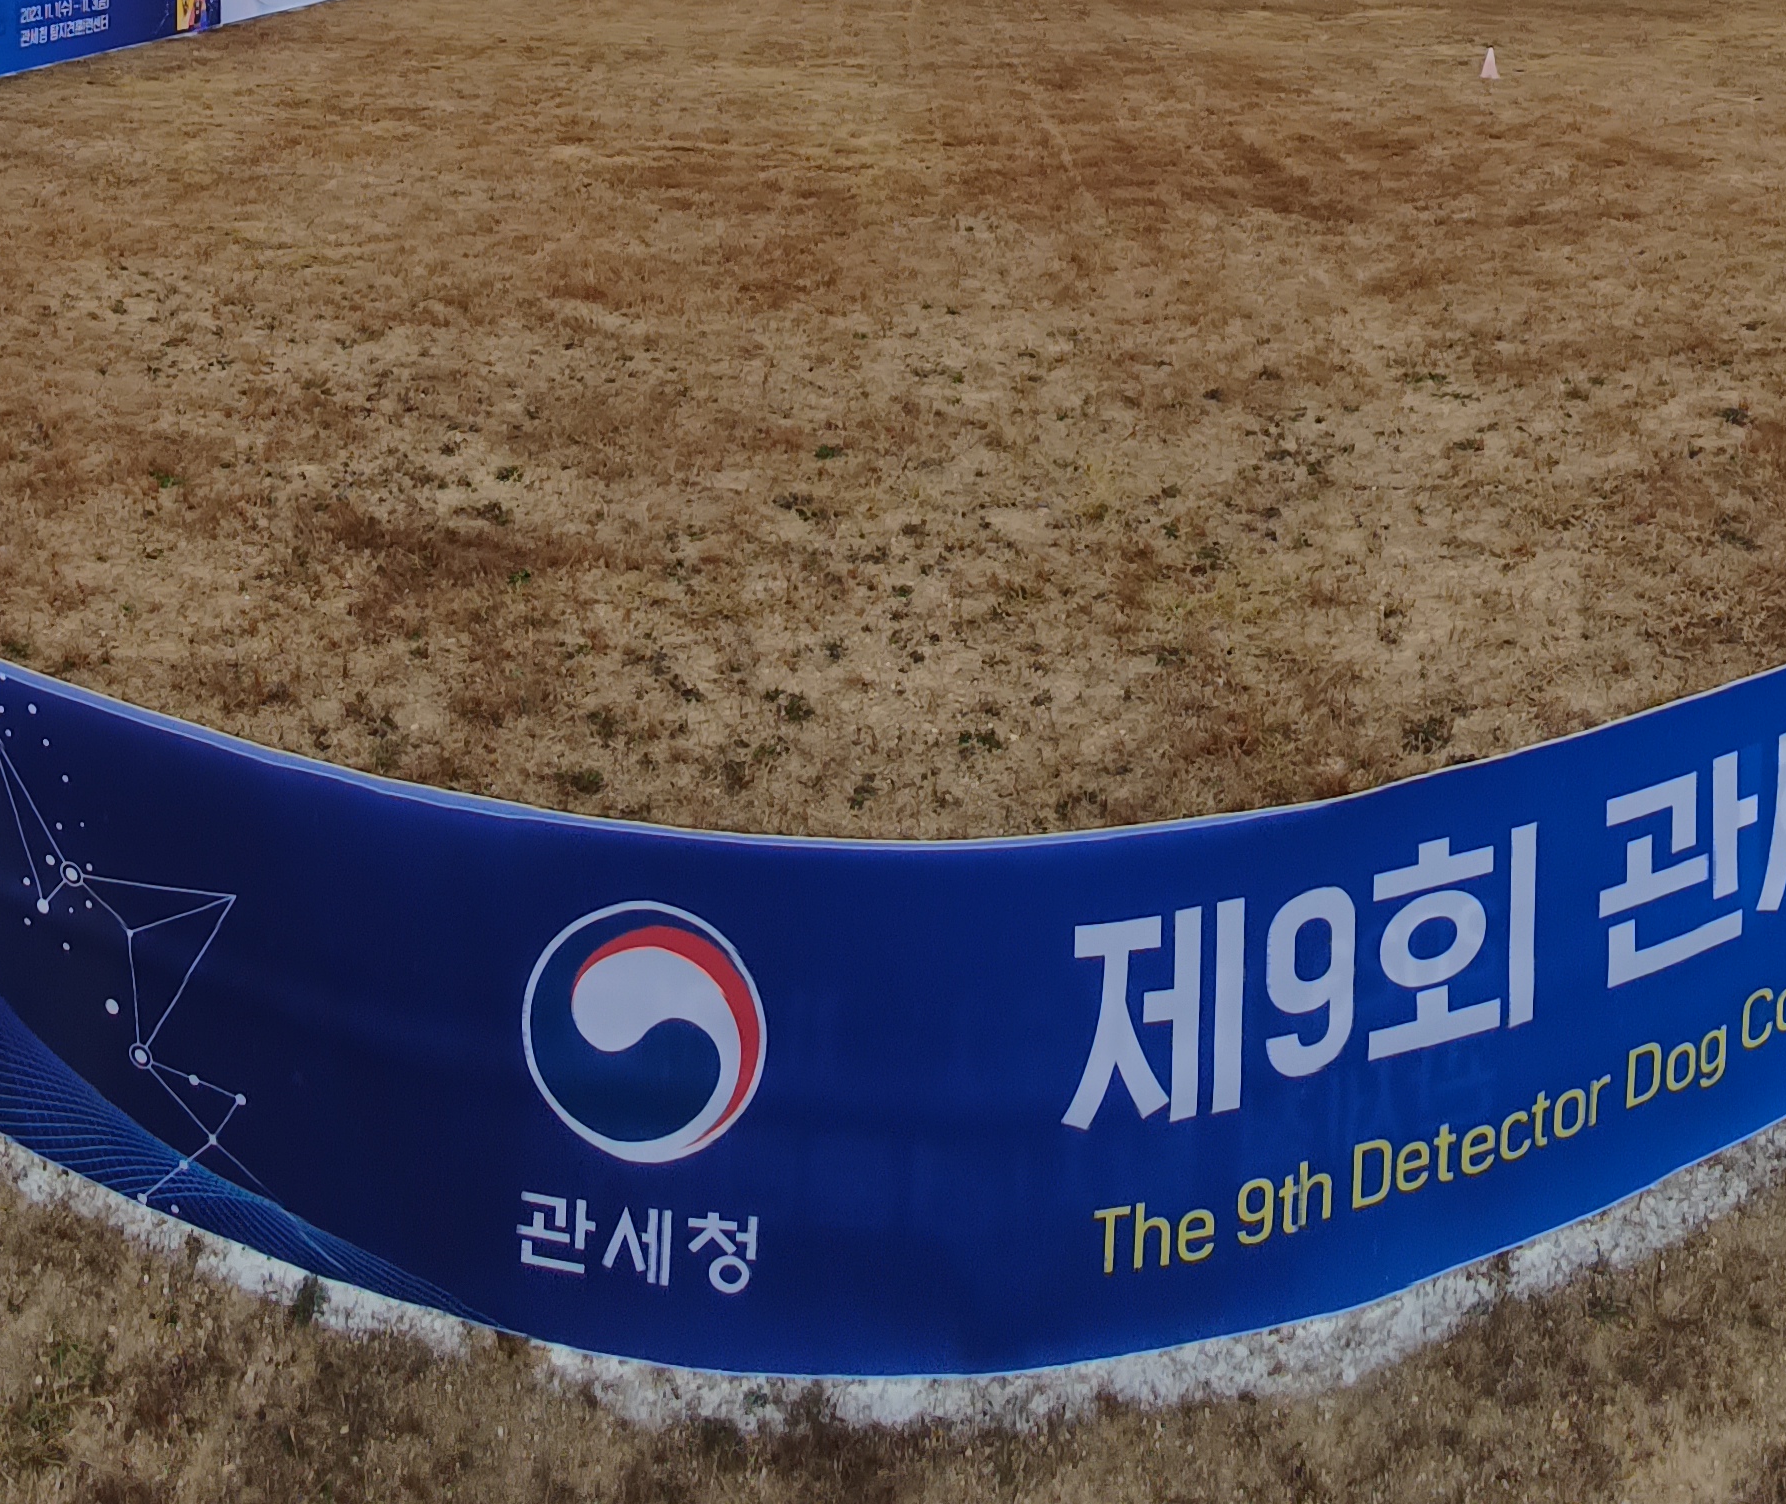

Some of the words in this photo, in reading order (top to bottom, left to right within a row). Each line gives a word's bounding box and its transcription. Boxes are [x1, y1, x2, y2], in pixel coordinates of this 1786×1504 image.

[1061, 822, 1537, 1131] 제9회
[516, 1191, 759, 1295] 관세청
[1094, 1200, 1216, 1274] The
[1237, 1160, 1332, 1245] 9th
[1352, 1073, 1611, 1209] Detector
[1626, 1025, 1728, 1110] Dog
